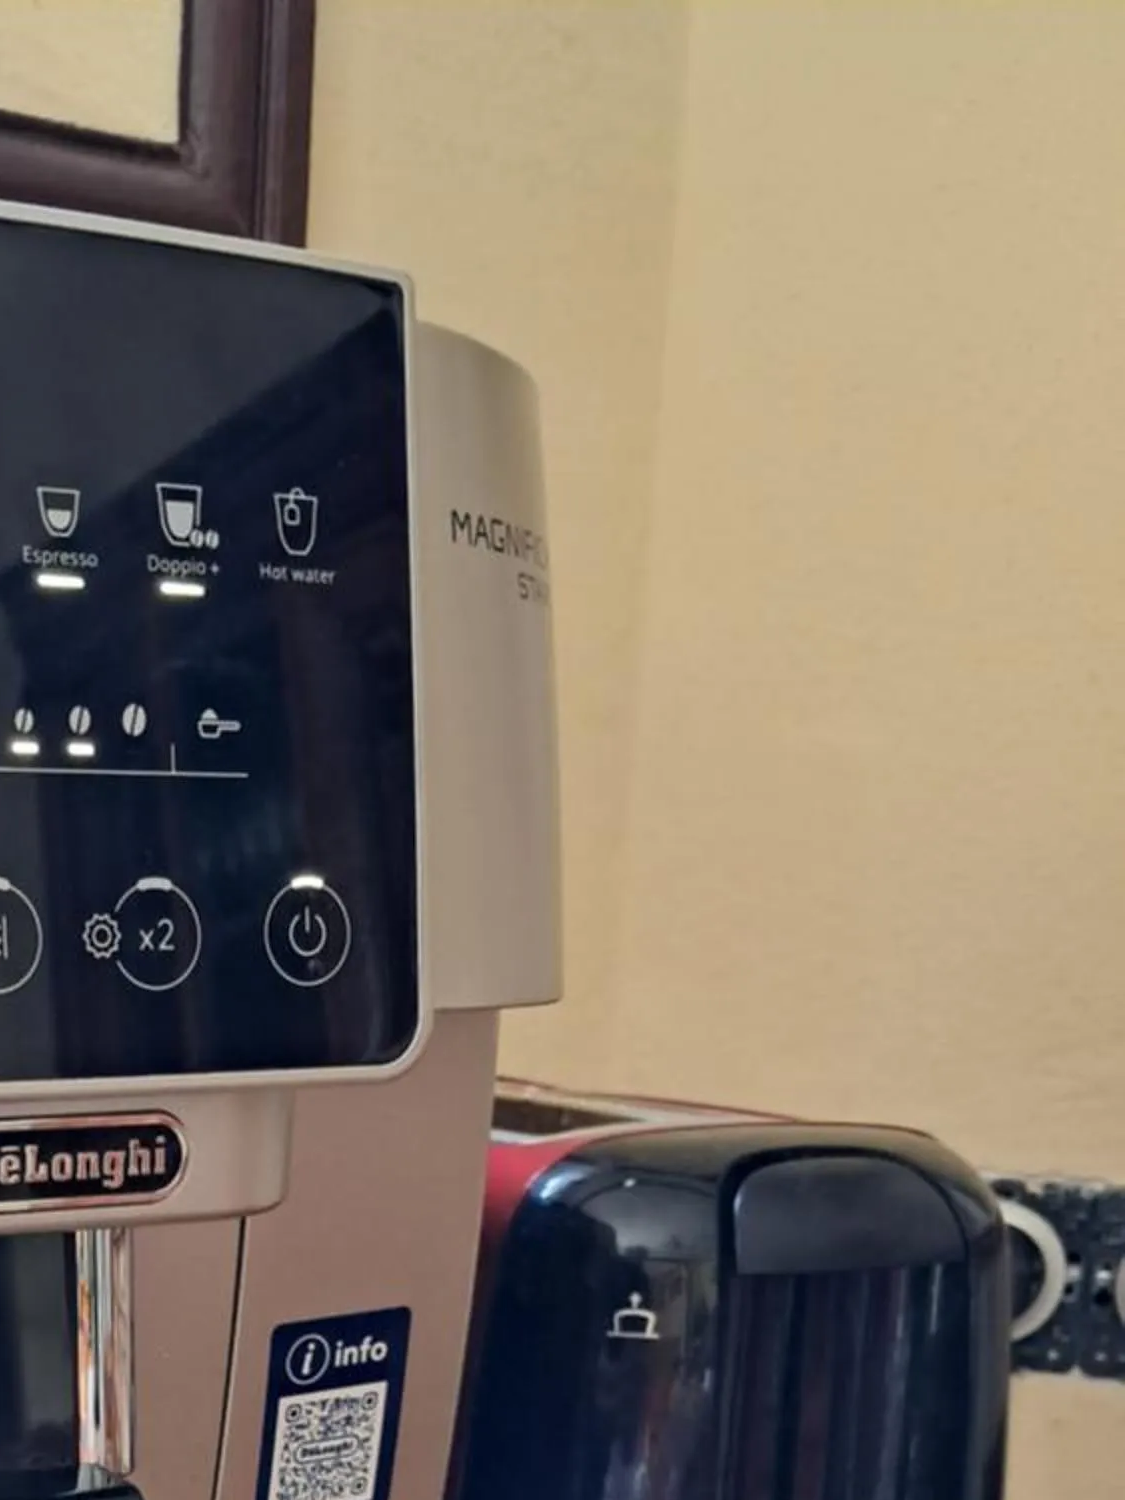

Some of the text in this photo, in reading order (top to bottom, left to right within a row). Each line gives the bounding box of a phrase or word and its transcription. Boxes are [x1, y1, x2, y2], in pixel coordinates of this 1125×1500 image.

[22, 545, 99, 568] Espresso
[147, 553, 207, 577] Doppio
[259, 562, 336, 585] Hot water
[138, 918, 175, 952] x2
[333, 1335, 389, 1368] info
